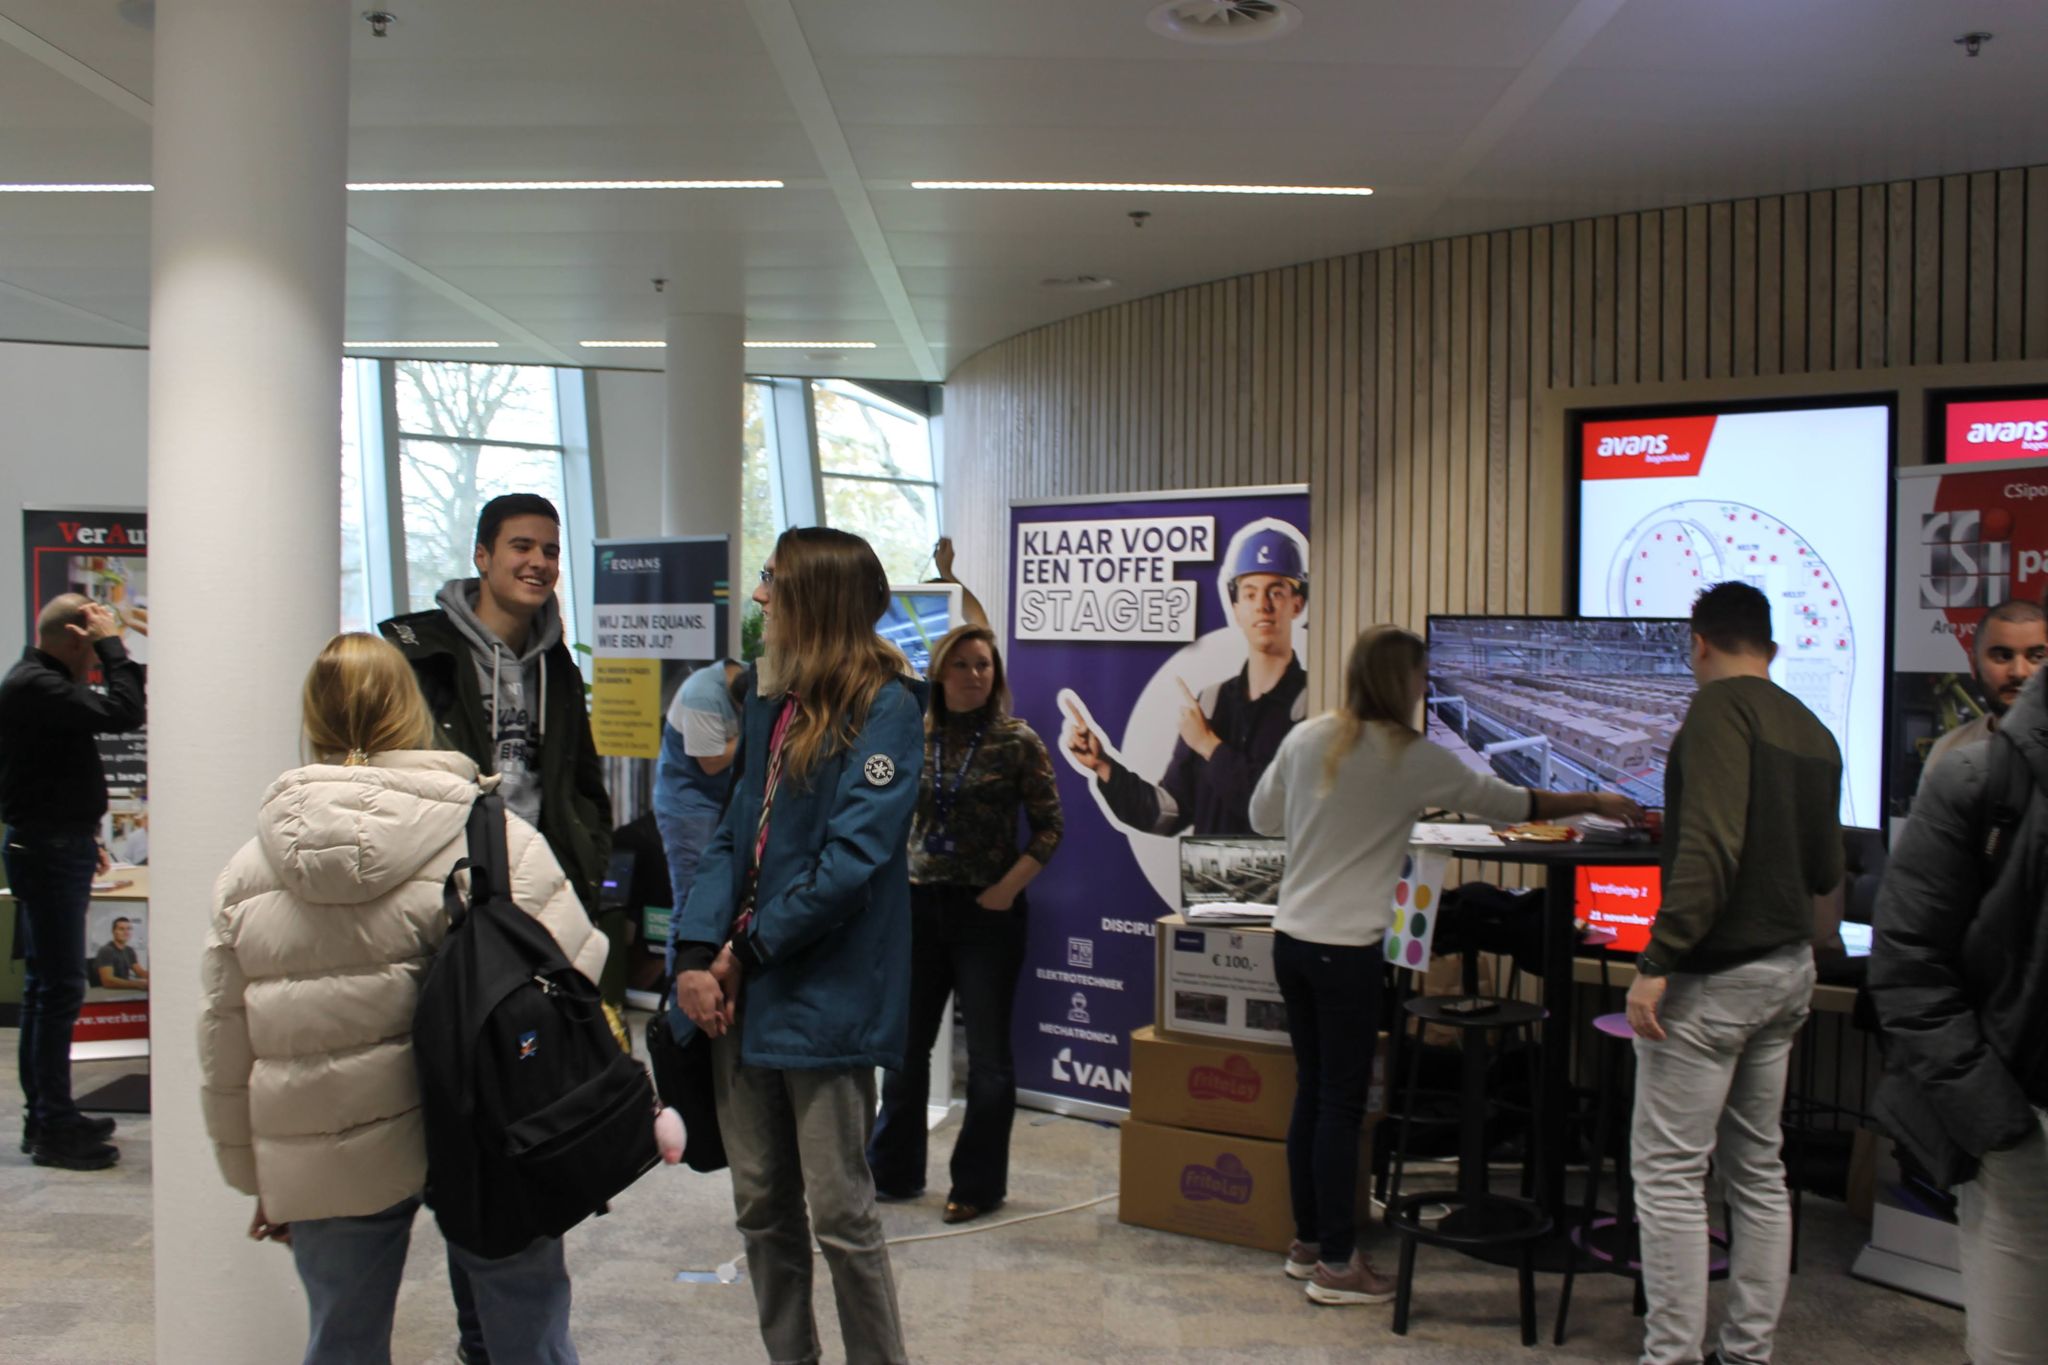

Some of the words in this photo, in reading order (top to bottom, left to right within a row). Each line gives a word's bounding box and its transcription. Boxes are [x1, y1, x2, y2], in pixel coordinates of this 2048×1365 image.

[1966, 420, 2048, 443] avans
[1597, 434, 1669, 457] avans
[57, 521, 147, 545] VerAu
[1024, 529, 1113, 556] KLAAR
[1121, 526, 1208, 553] VOOR
[611, 557, 660, 571] EQUANS
[1023, 559, 1070, 584] EEN
[1078, 557, 1165, 583] TOFFE
[1020, 586, 1191, 633] STAGE?
[598, 615, 618, 629] WIJ
[621, 615, 649, 629] ZIJN
[598, 635, 618, 648] WIE
[621, 635, 646, 648] BEN
[1590, 882, 1640, 899] Verdieping
[1211, 953, 1221, 968] €
[1225, 955, 1258, 971] 100,-
[1036, 967, 1125, 992] ELEKTROTECHNIEK
[1039, 1022, 1119, 1046] MECHATRONICA
